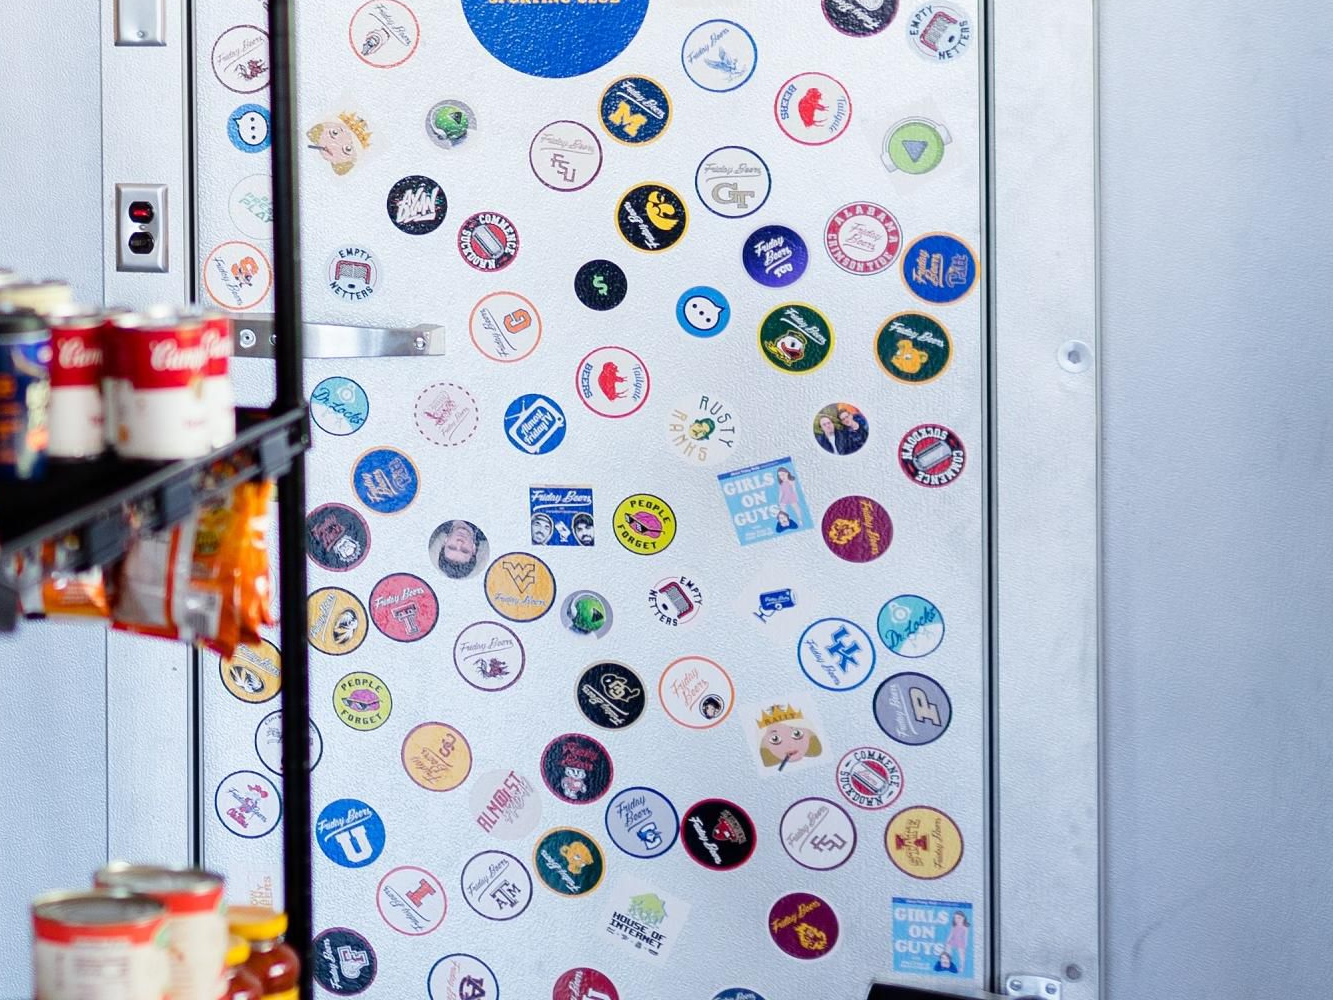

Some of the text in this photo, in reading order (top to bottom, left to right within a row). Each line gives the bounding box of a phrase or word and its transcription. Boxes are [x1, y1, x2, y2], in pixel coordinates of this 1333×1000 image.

[374, 3, 396, 27] Friday
[909, 5, 934, 35] EMPTY
[687, 27, 730, 64] Friday Beers
[938, 20, 971, 60] NETTERS
[217, 49, 241, 64] Friday
[620, 81, 666, 119] Friday Beers
[608, 101, 648, 137] M
[540, 134, 595, 153] Friday Beers
[551, 153, 576, 183] FSU
[703, 162, 762, 177] Friday Beers
[478, 214, 517, 256] COMMENCE
[834, 204, 897, 244] ALABAMA
[848, 223, 882, 243] Friday
[338, 248, 372, 260] EMPTY
[460, 228, 496, 269] SUCKDOWN
[753, 236, 784, 257] Friday
[827, 233, 895, 272] CRIMSON TIDE
[844, 232, 876, 250] Beers
[214, 256, 231, 284] Friday
[764, 246, 792, 266] Beers
[913, 249, 930, 285] Friday
[773, 263, 794, 278] TCU
[329, 282, 374, 301] NETTERS
[784, 308, 827, 345] Friday Beers
[888, 321, 945, 348] Friday Beers
[488, 329, 510, 358] Friday
[581, 362, 593, 399] BEERS
[631, 365, 646, 401] Tailgate
[332, 399, 364, 424] Locks
[521, 410, 544, 435] Almost
[700, 395, 735, 448] RUSTY
[902, 427, 948, 461] SUCKDOWN
[915, 450, 963, 486] COMMENCE
[531, 490, 593, 504] Friday Beers
[724, 472, 775, 496] GIRLS
[630, 499, 671, 524] PEOPLE
[741, 490, 767, 508] ON
[733, 504, 779, 526] GUYS
[861, 500, 875, 530] Friday
[616, 524, 658, 550] FORGET
[373, 586, 424, 608] Friday Beers
[493, 594, 547, 607] Friday Beers
[679, 575, 703, 606] EMPTY
[648, 588, 678, 627] NETTERS
[906, 606, 937, 635] Locks
[459, 637, 514, 652] Friday Beers
[806, 638, 825, 667] Friday
[340, 677, 383, 693] PEOPLE
[670, 668, 699, 697] Friday
[683, 679, 709, 707] Beers
[339, 709, 383, 724] FORGET
[599, 702, 625, 726] Friday
[764, 712, 796, 726] RALLY
[854, 750, 900, 788] COMMENCE
[840, 771, 884, 806] SUCKDOWN
[317, 806, 373, 835] Friday Beers
[615, 795, 646, 818] Friday
[625, 807, 652, 825] Beers
[787, 804, 830, 845] Friday Beers
[334, 825, 373, 863] U
[688, 816, 722, 865] Friday Beers
[810, 833, 847, 853] FSU
[933, 843, 944, 869] Friday
[467, 858, 510, 896] Friday Beers
[557, 868, 581, 893] Friday
[383, 886, 425, 931] Friday Beers
[771, 900, 822, 932] Friday Beers
[894, 908, 949, 925] GIRLS
[609, 919, 664, 950] INTERNET
[612, 911, 666, 941] HOUSE OF
[909, 925, 935, 939] ON
[894, 940, 946, 956] GUYS
[322, 938, 341, 990] Friday Beers
